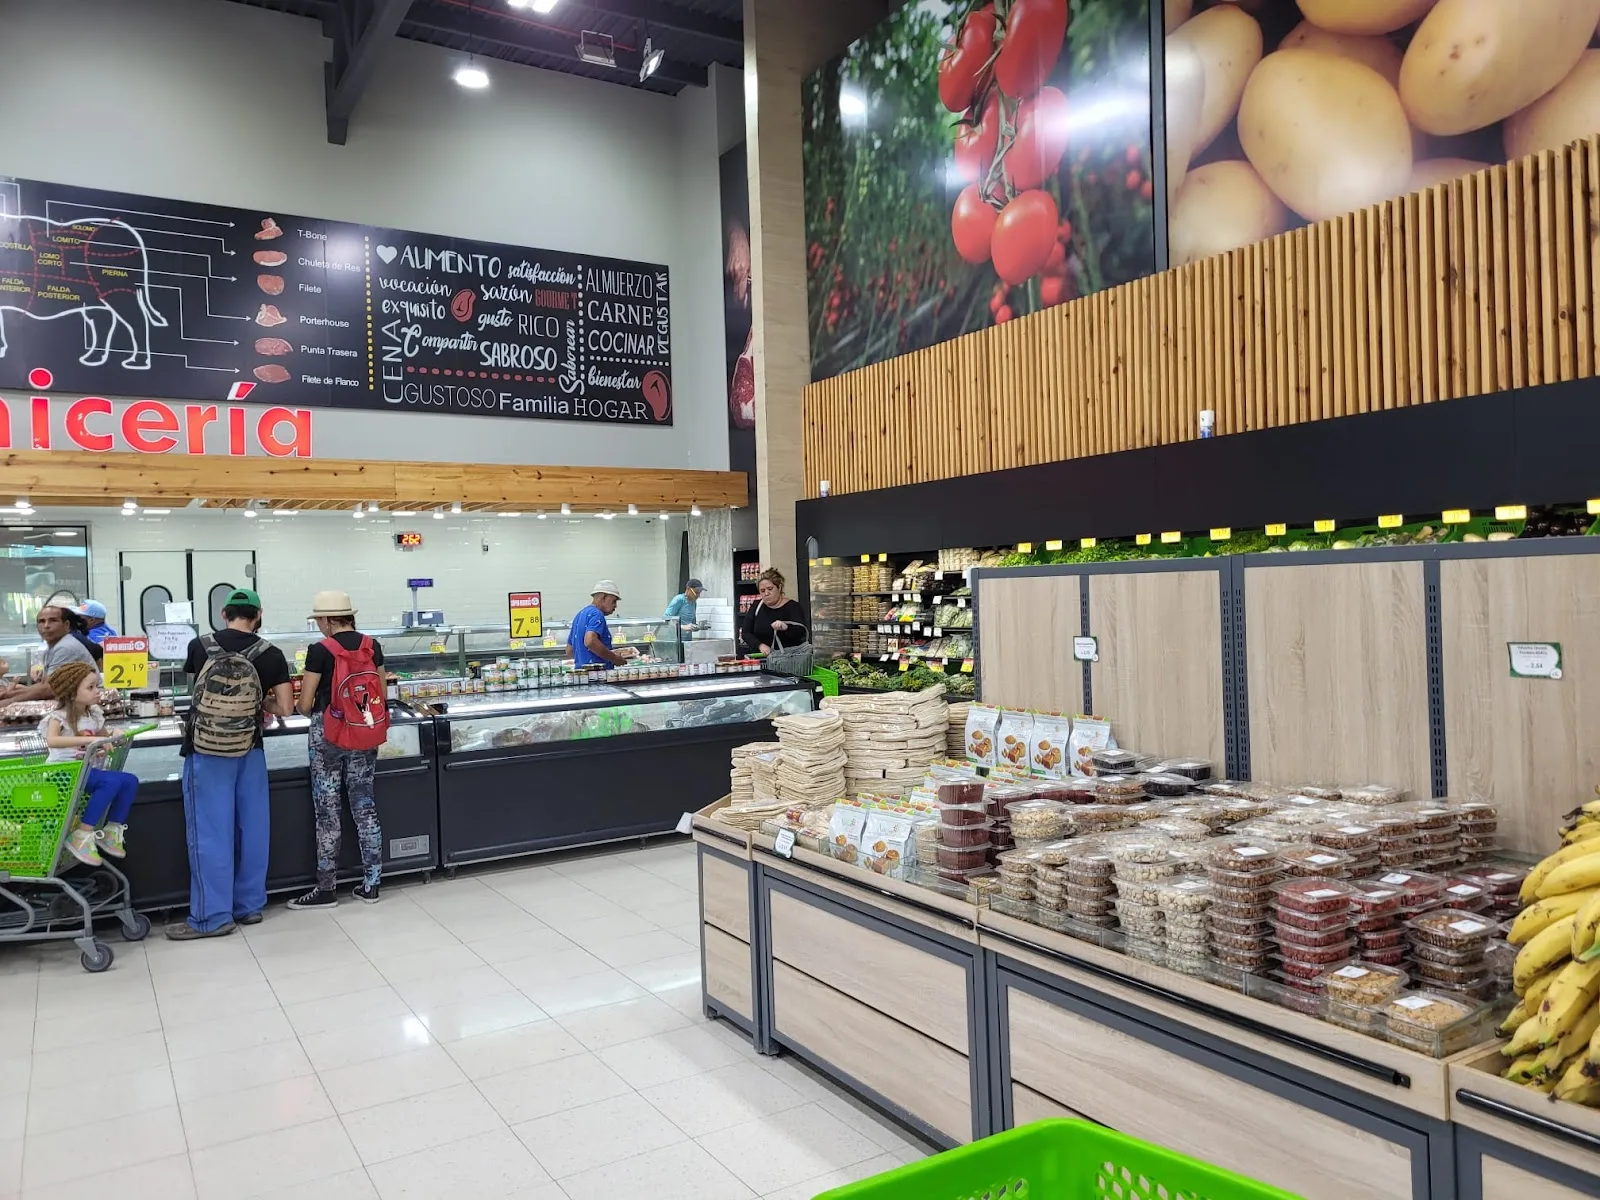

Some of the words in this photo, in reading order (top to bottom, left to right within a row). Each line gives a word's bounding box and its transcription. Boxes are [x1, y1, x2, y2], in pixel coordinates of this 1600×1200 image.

[52, 236, 81, 245] LOMITO
[297, 229, 328, 241] T-Bone
[37, 259, 63, 267] CORTO
[39, 251, 60, 260] LOMO
[298, 258, 331, 269] Chuleta
[332, 262, 343, 271] de
[344, 264, 361, 273] Res
[400, 245, 502, 278] ALIMENTO
[1, 277, 25, 286] FALDA
[101, 269, 128, 278] PIERNA
[507, 260, 576, 285] satisfacción
[0, 284, 31, 294] NTERIOR
[47, 285, 71, 293] FALDA
[299, 283, 322, 294] Filete
[379, 276, 452, 297] vocación
[480, 284, 533, 304] sazón
[586, 268, 653, 299] ALMUERZO
[37, 292, 81, 301] POSTERIOR
[534, 288, 578, 310] GOURMET
[381, 298, 446, 323] exquisito
[477, 307, 515, 331] gusto
[587, 300, 654, 327] CARNE
[655, 271, 669, 354] DEGUSTAR
[300, 315, 350, 328] Porterhouse
[518, 313, 560, 338] RICO
[400, 323, 479, 358] Compartir
[588, 329, 655, 356] COCINAR
[300, 345, 326, 355] Punta
[327, 346, 358, 358] Trasera
[381, 318, 404, 404] CENA
[480, 340, 557, 371] SABROSO
[558, 318, 585, 396] Saborear
[301, 374, 322, 384] Filete
[323, 375, 334, 385] de
[335, 377, 360, 387] Flanco
[587, 365, 642, 390] bienestar
[404, 382, 496, 408] GUSTOSO
[499, 392, 569, 414] Familia
[573, 398, 648, 419] HOGAR
